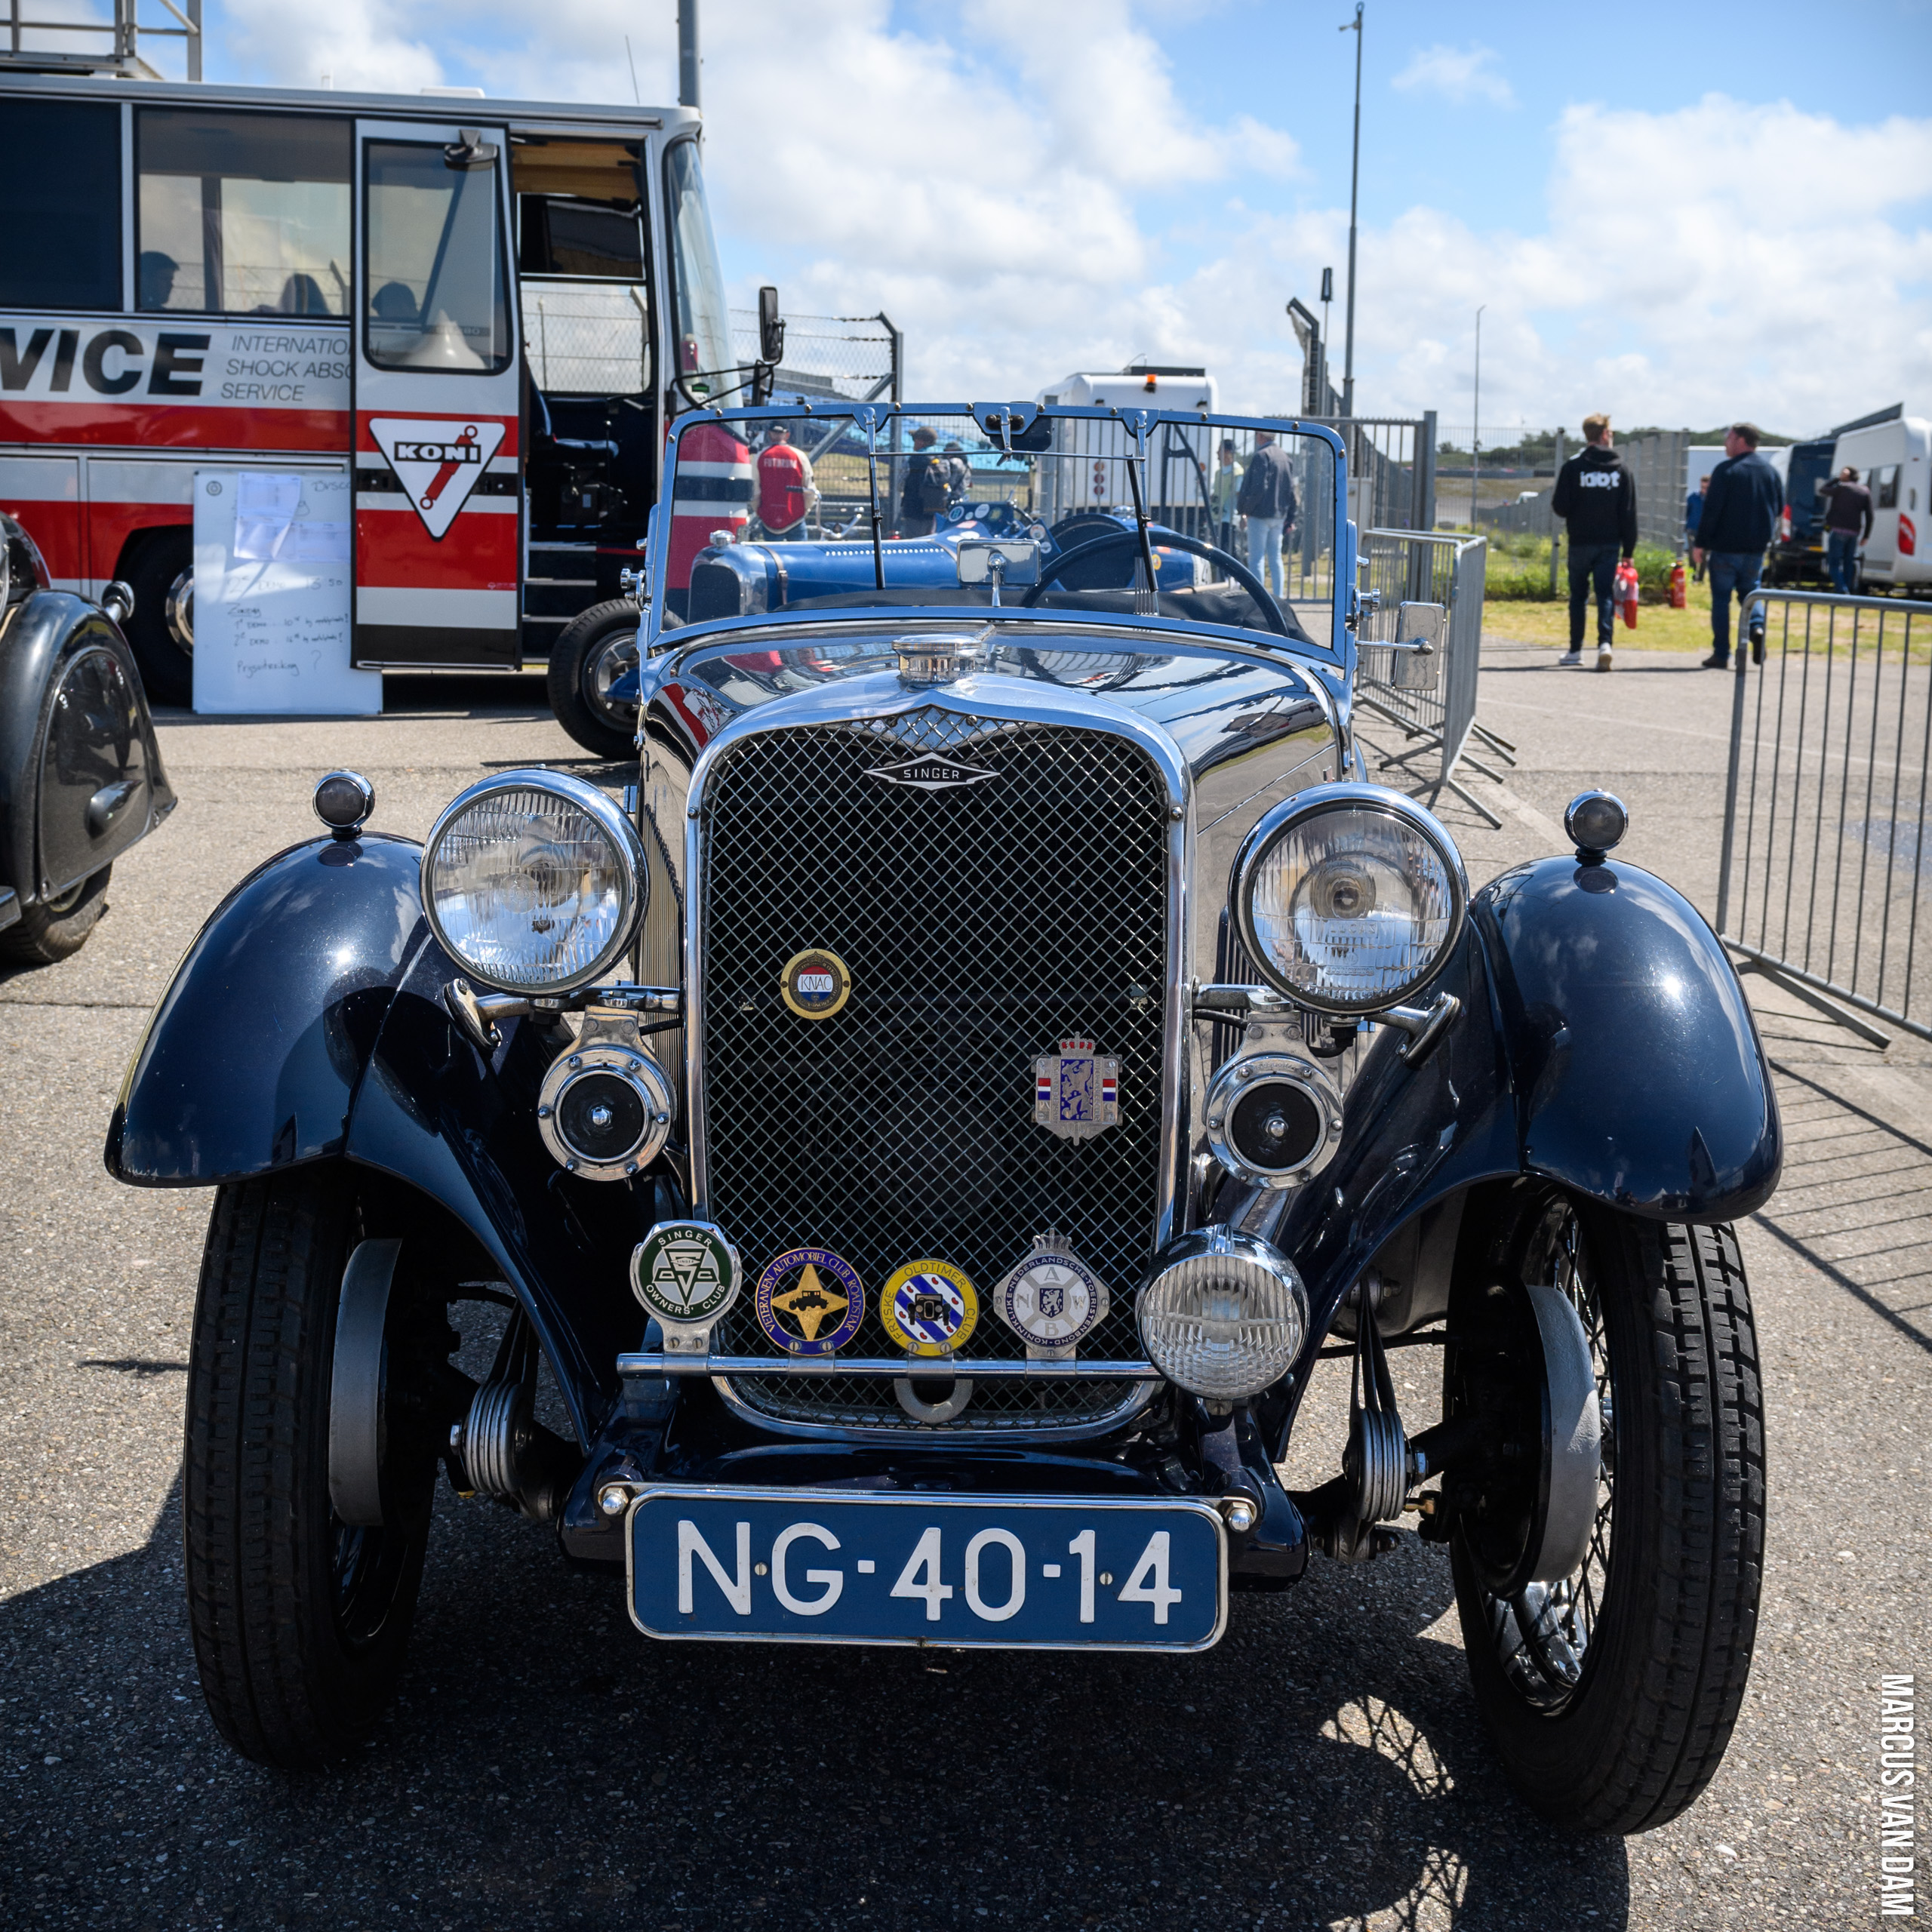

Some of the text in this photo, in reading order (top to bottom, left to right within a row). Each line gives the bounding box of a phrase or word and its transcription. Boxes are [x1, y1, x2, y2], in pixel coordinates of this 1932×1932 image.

[232, 334, 351, 355] INTERNATIO
[226, 358, 300, 377] SHOCK
[220, 382, 306, 401] SERVICE
[397, 444, 478, 461] KONI
[903, 768, 959, 779] SINGER
[801, 976, 832, 991] KNAC
[657, 1229, 712, 1247] SINGER
[646, 1284, 725, 1315] OWNERS' CLUB
[758, 1251, 862, 1333] VETERANEN AUTOMOBIEL CLUB ROADSTAR
[883, 1262, 976, 1340] FRYSKE OLDTIMER CLUB
[1006, 1257, 1097, 1346] KONINKLIJKE NEDERLANDSCHE TOERISTENBOND
[678, 1519, 1182, 1625] NG-40-14
